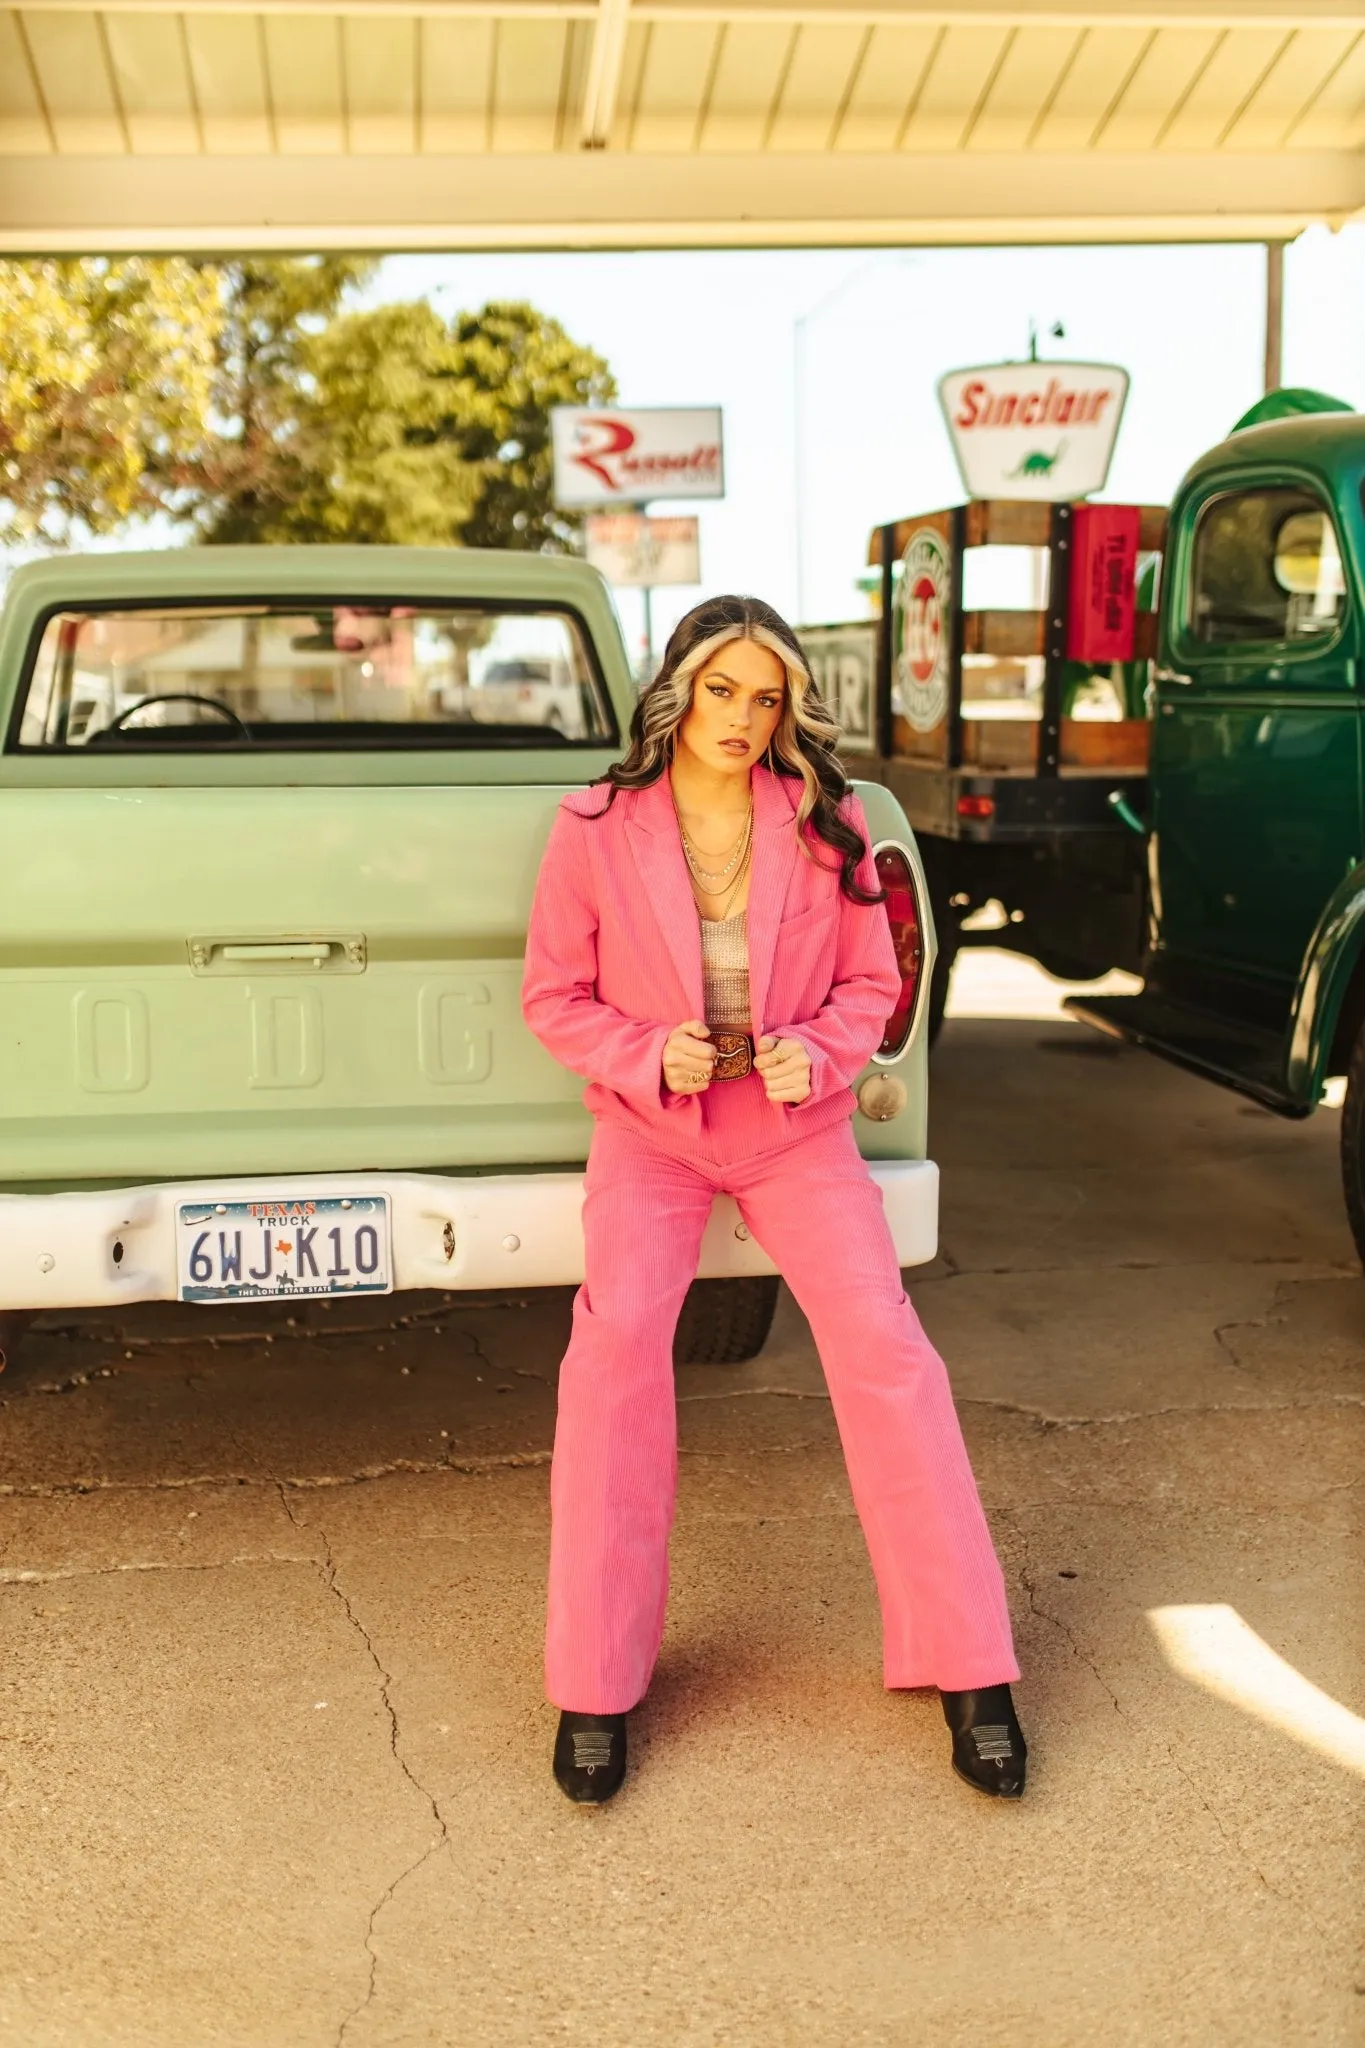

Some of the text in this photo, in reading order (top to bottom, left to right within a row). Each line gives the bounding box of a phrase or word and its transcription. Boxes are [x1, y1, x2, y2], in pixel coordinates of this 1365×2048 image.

[955, 377, 1112, 431] Sinclair
[247, 1201, 316, 1217] TEXAS
[257, 1216, 310, 1227] TRUCK
[257, 1287, 279, 1296] LONE
[284, 1286, 305, 1294] STAR
[308, 1284, 332, 1293] STATE
